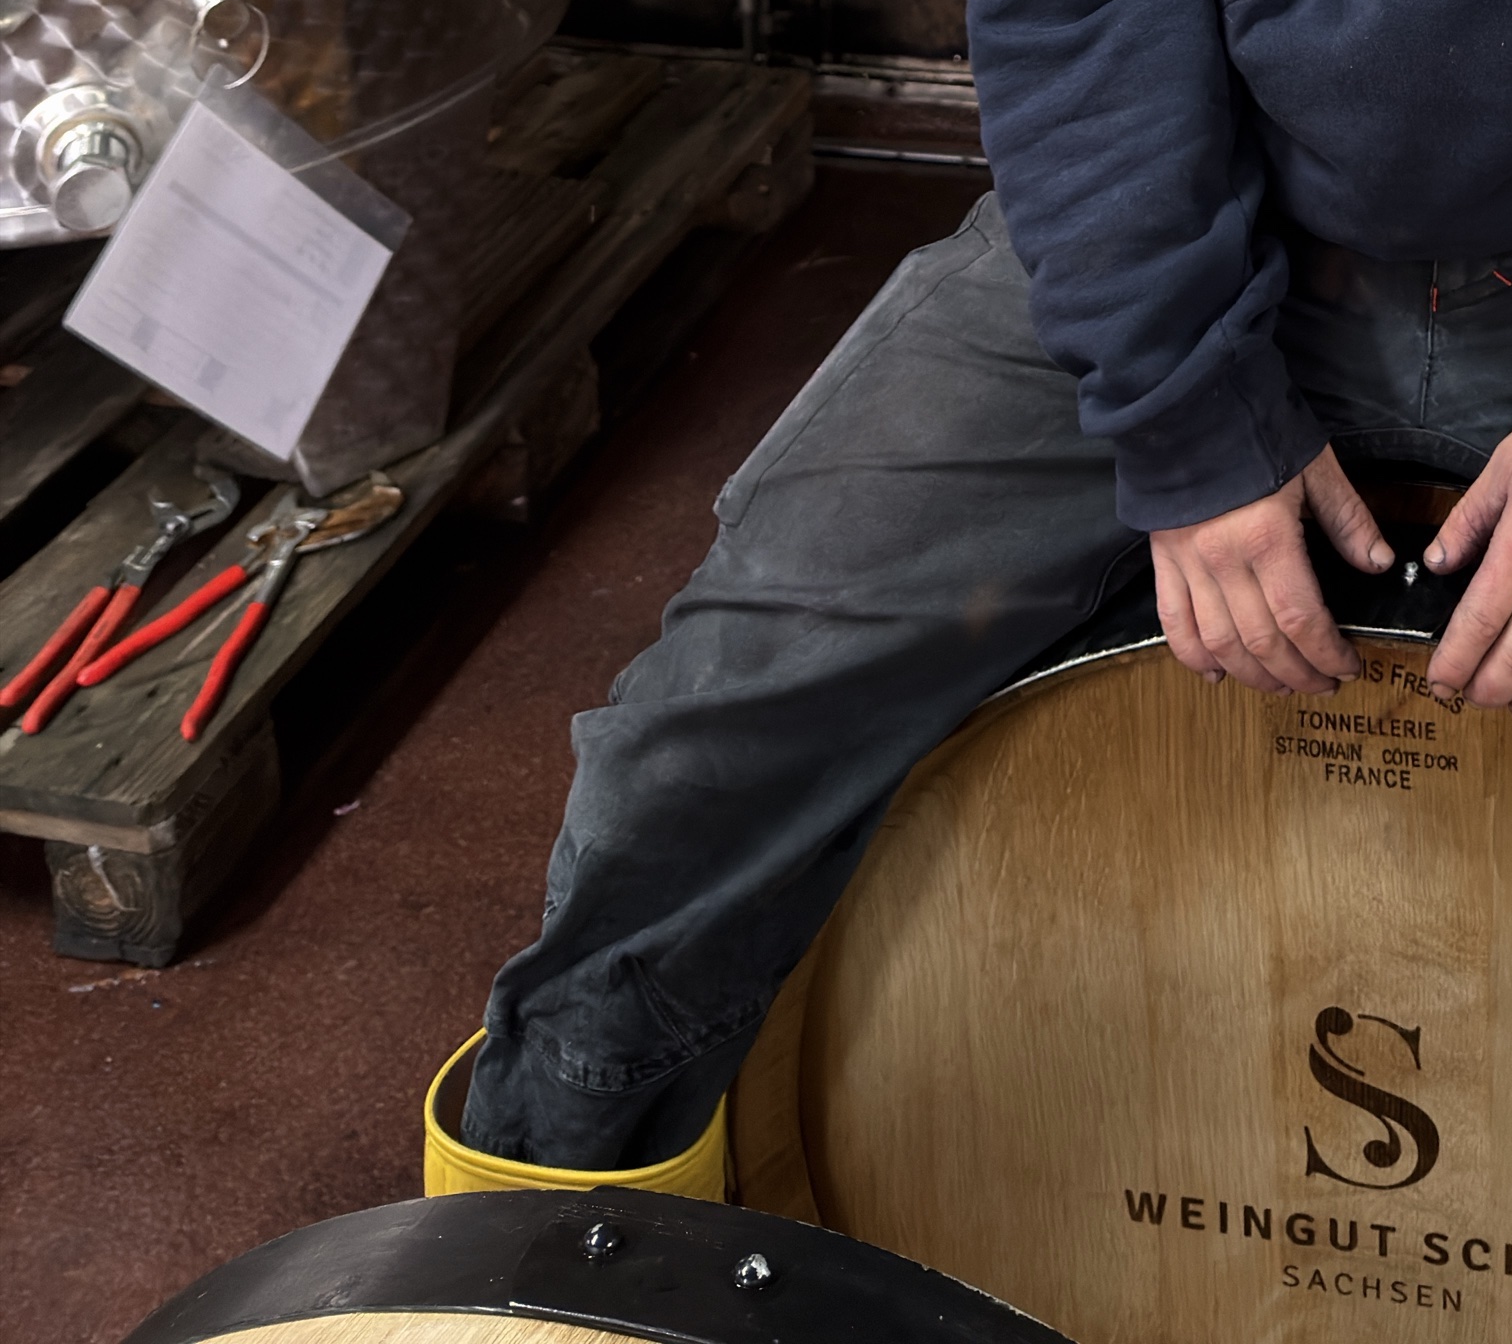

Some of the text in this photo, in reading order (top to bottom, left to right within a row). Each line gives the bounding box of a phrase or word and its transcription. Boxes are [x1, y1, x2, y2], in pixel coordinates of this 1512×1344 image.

[1297, 710, 1437, 741] TONNELLERIE
[1325, 763, 1412, 790] FRANCE
[1304, 1006, 1440, 1190] S
[1125, 1189, 1396, 1257] WEINGUT
[1281, 1265, 1462, 1312] SACHSEN
